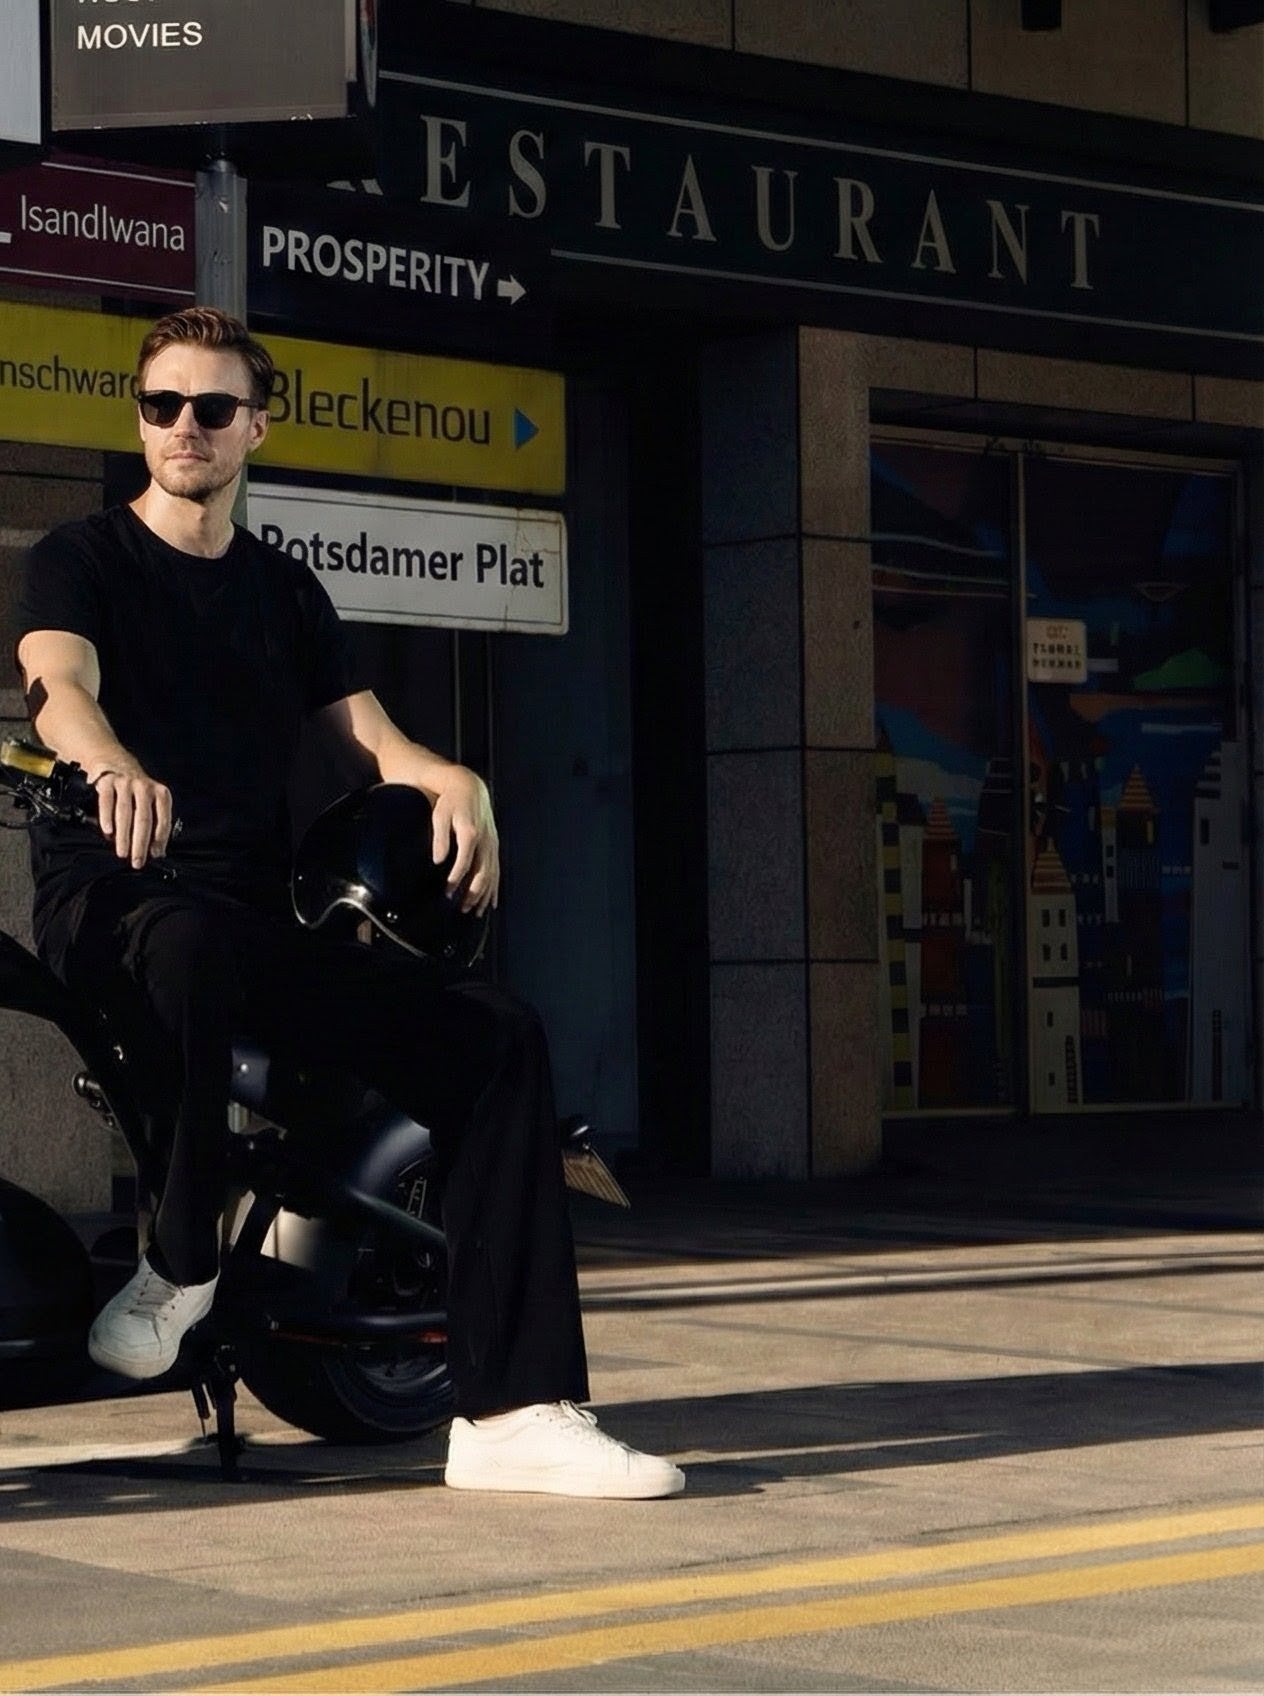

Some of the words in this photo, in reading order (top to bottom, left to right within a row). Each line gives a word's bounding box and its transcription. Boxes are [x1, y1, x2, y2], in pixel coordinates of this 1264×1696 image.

[78, 22, 203, 49] MOVIES
[21, 195, 185, 251] Isandlwana
[325, 114, 1100, 290] ESTAURANT
[262, 225, 490, 300] PROSPERITY
[475, 542, 545, 588] Plat
